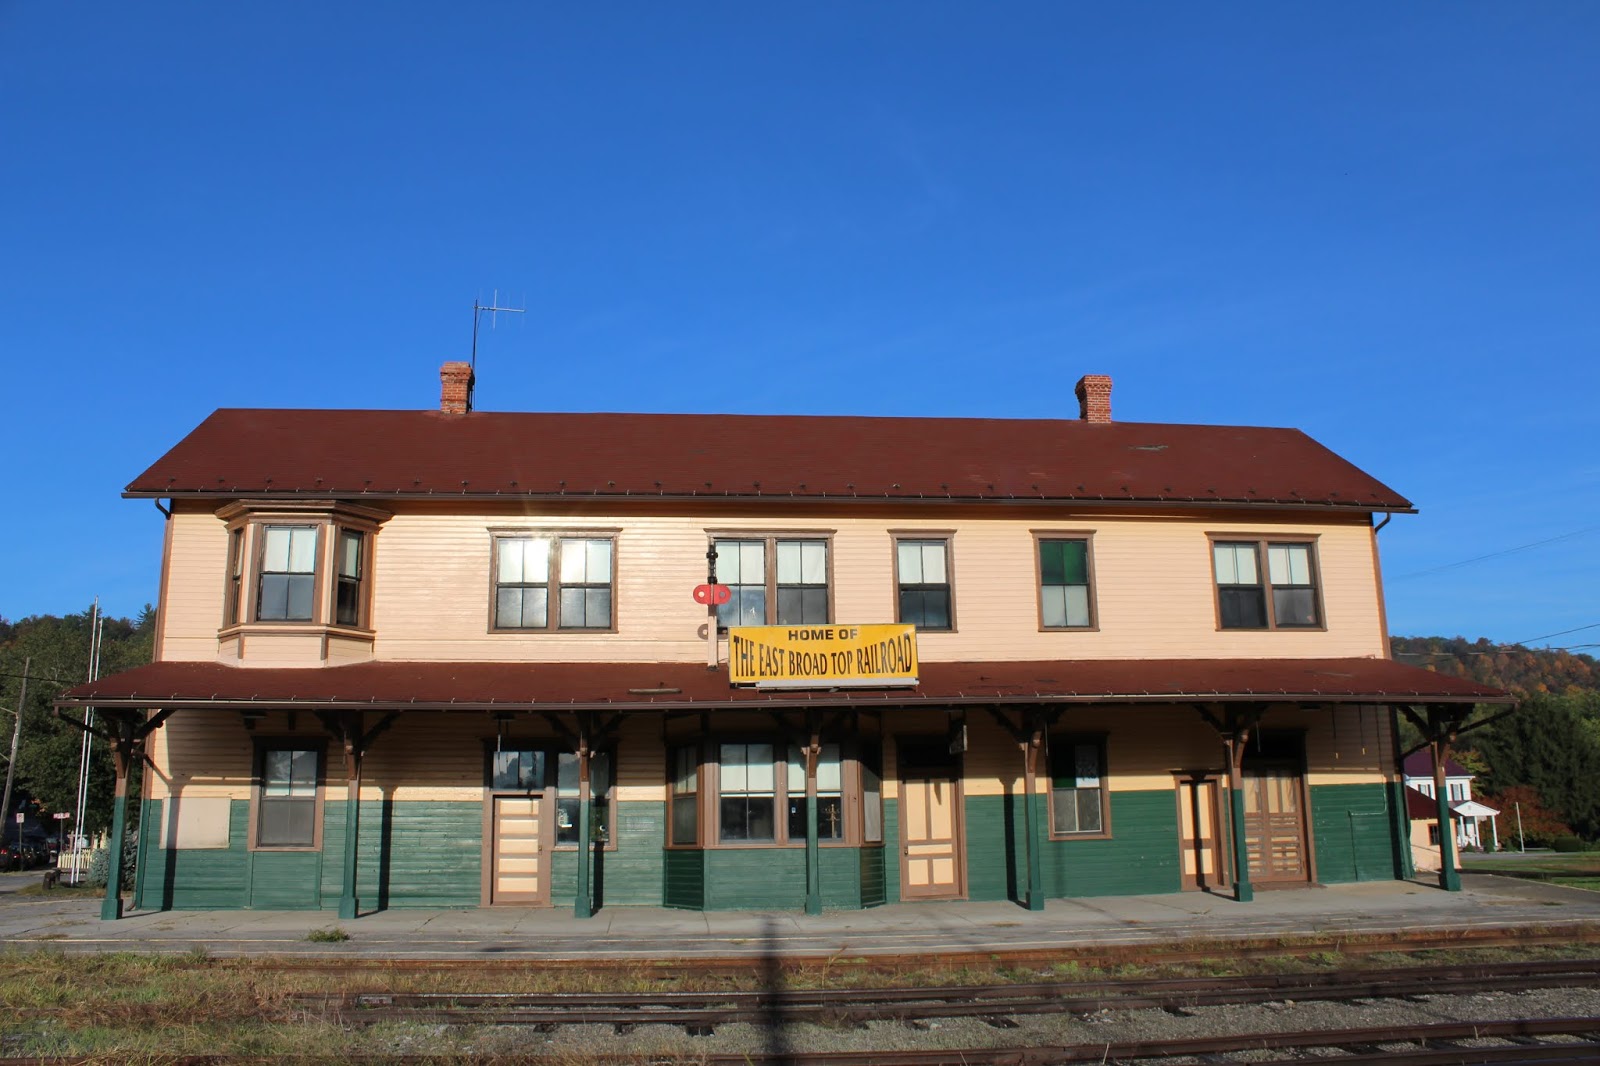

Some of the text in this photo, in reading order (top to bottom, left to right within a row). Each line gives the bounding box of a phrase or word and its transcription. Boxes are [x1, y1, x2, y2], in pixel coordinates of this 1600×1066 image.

[788, 628, 858, 641] HOME OF
[733, 632, 912, 677] THE EAST BROAD TOP RAILROAD
